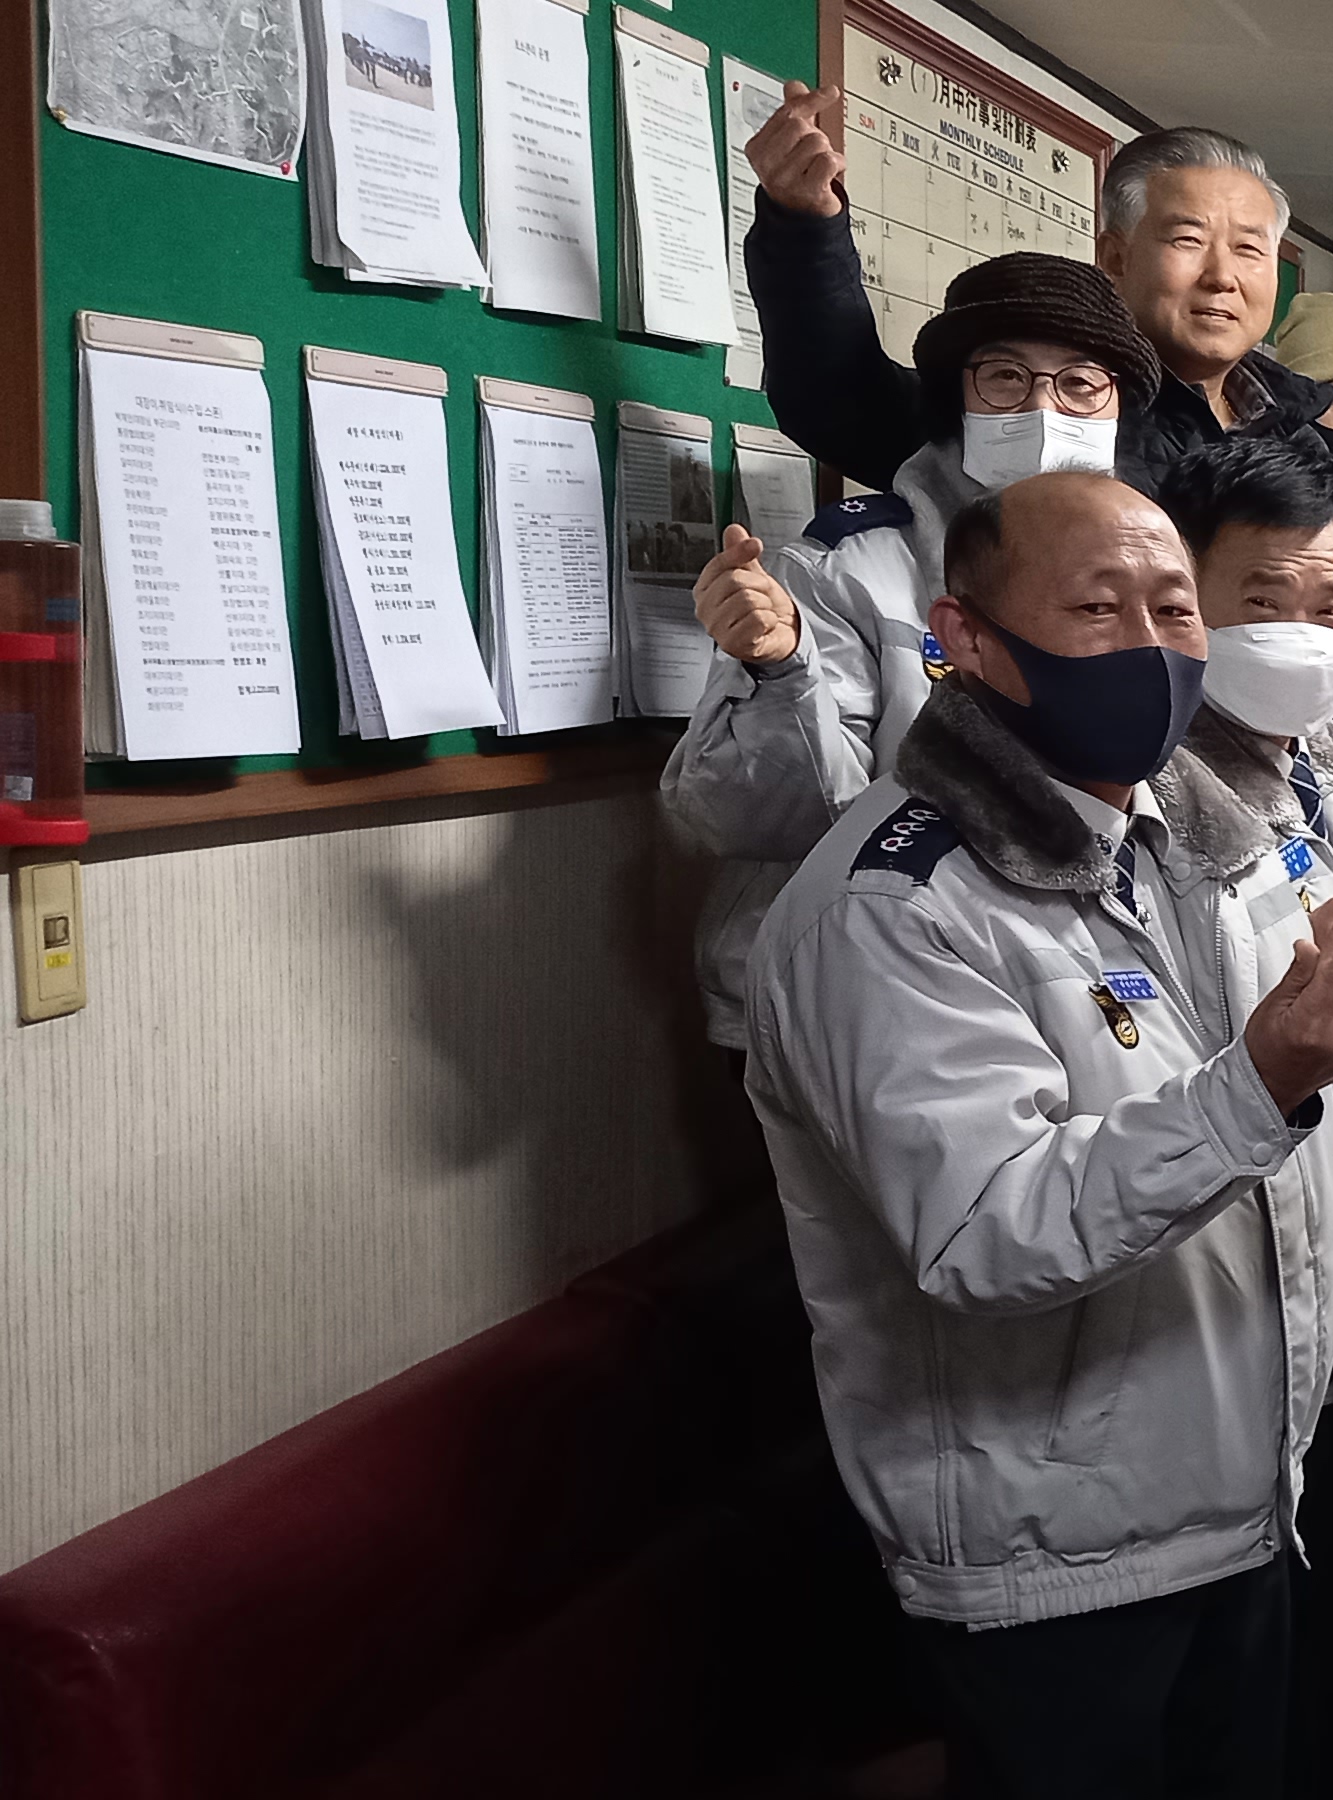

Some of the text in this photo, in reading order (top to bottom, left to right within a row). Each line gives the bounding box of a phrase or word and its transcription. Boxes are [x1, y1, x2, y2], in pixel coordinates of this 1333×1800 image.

[902, 131, 920, 153] MON
[939, 119, 1025, 173] MONTHLY SCHEDULE
